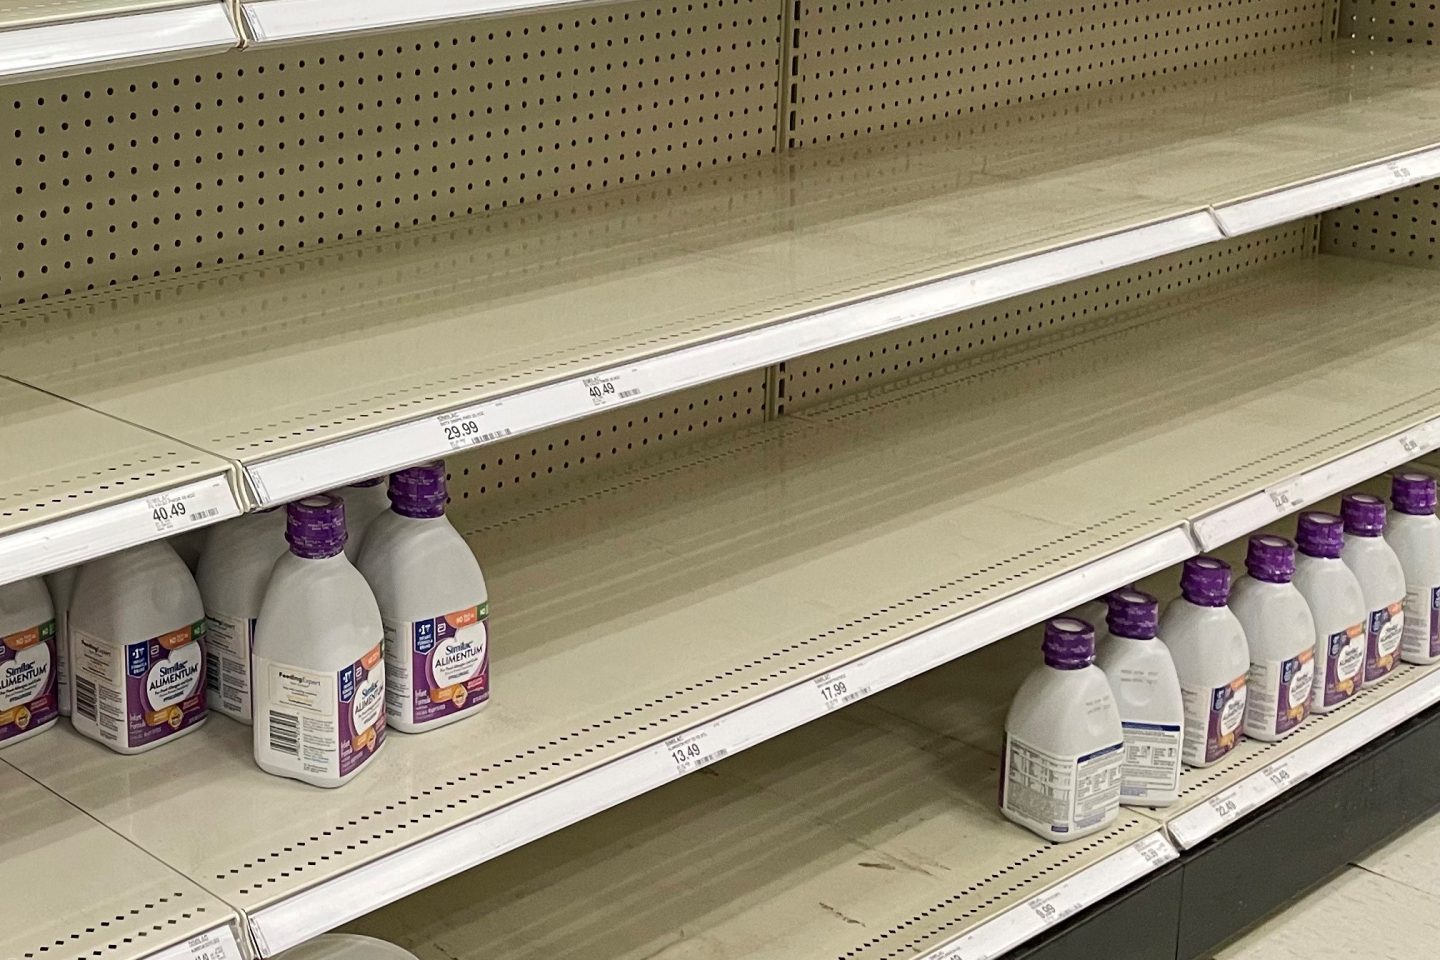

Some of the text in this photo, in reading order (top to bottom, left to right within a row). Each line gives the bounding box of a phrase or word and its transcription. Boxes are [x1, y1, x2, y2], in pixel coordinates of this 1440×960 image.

[590, 382, 615, 397] 40.49
[444, 421, 479, 440] 29.99
[153, 502, 186, 521] 40.49
[435, 644, 483, 668] ALIMENTUM
[445, 640, 474, 656] Similac
[6, 661, 35, 678] Similac
[149, 663, 199, 691] ALIMENTUM
[159, 660, 188, 677] Similac
[821, 681, 847, 700] 17.99
[672, 743, 700, 764] 13.49
